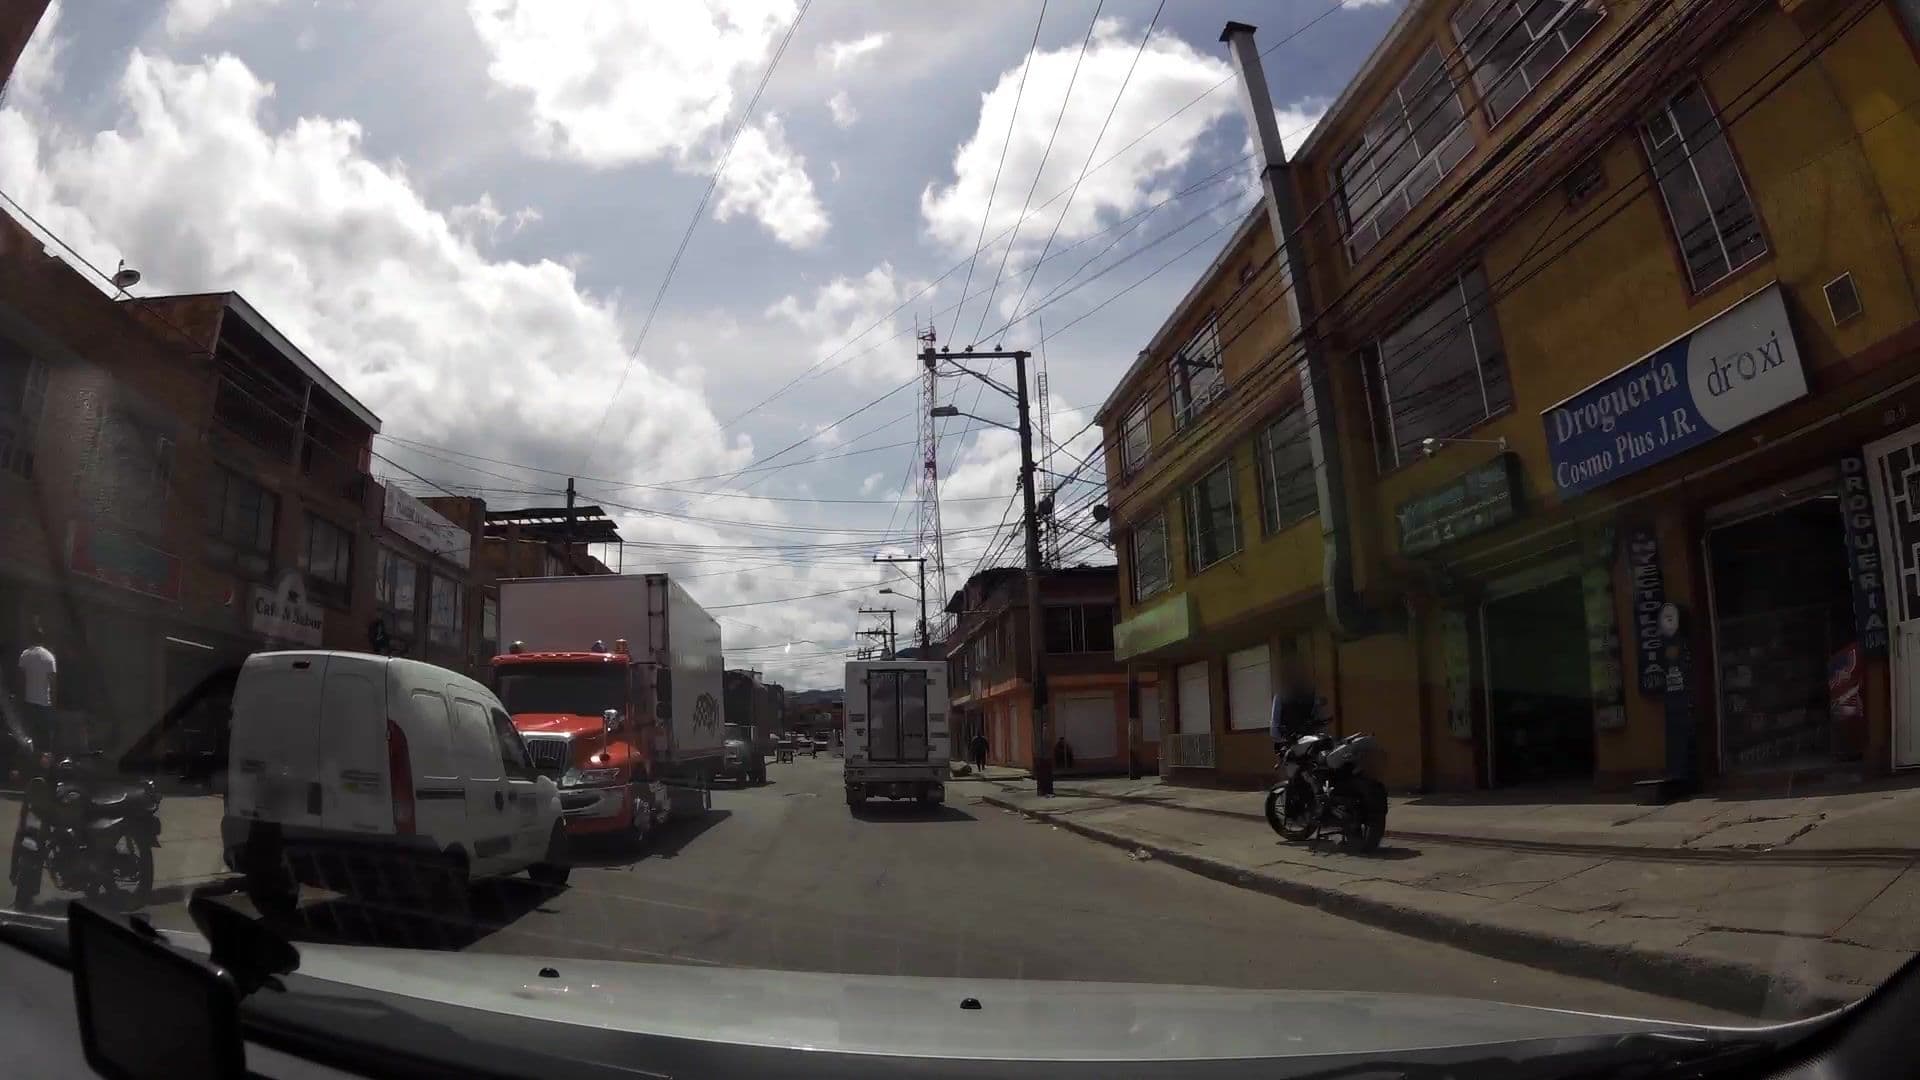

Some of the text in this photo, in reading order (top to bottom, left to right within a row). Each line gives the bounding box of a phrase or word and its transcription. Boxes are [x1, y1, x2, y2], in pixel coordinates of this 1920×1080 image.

[1553, 358, 1680, 444] Droguería
[1707, 330, 1785, 397] droxi
[1557, 407, 1697, 488] Cosmo Plus J.R.
